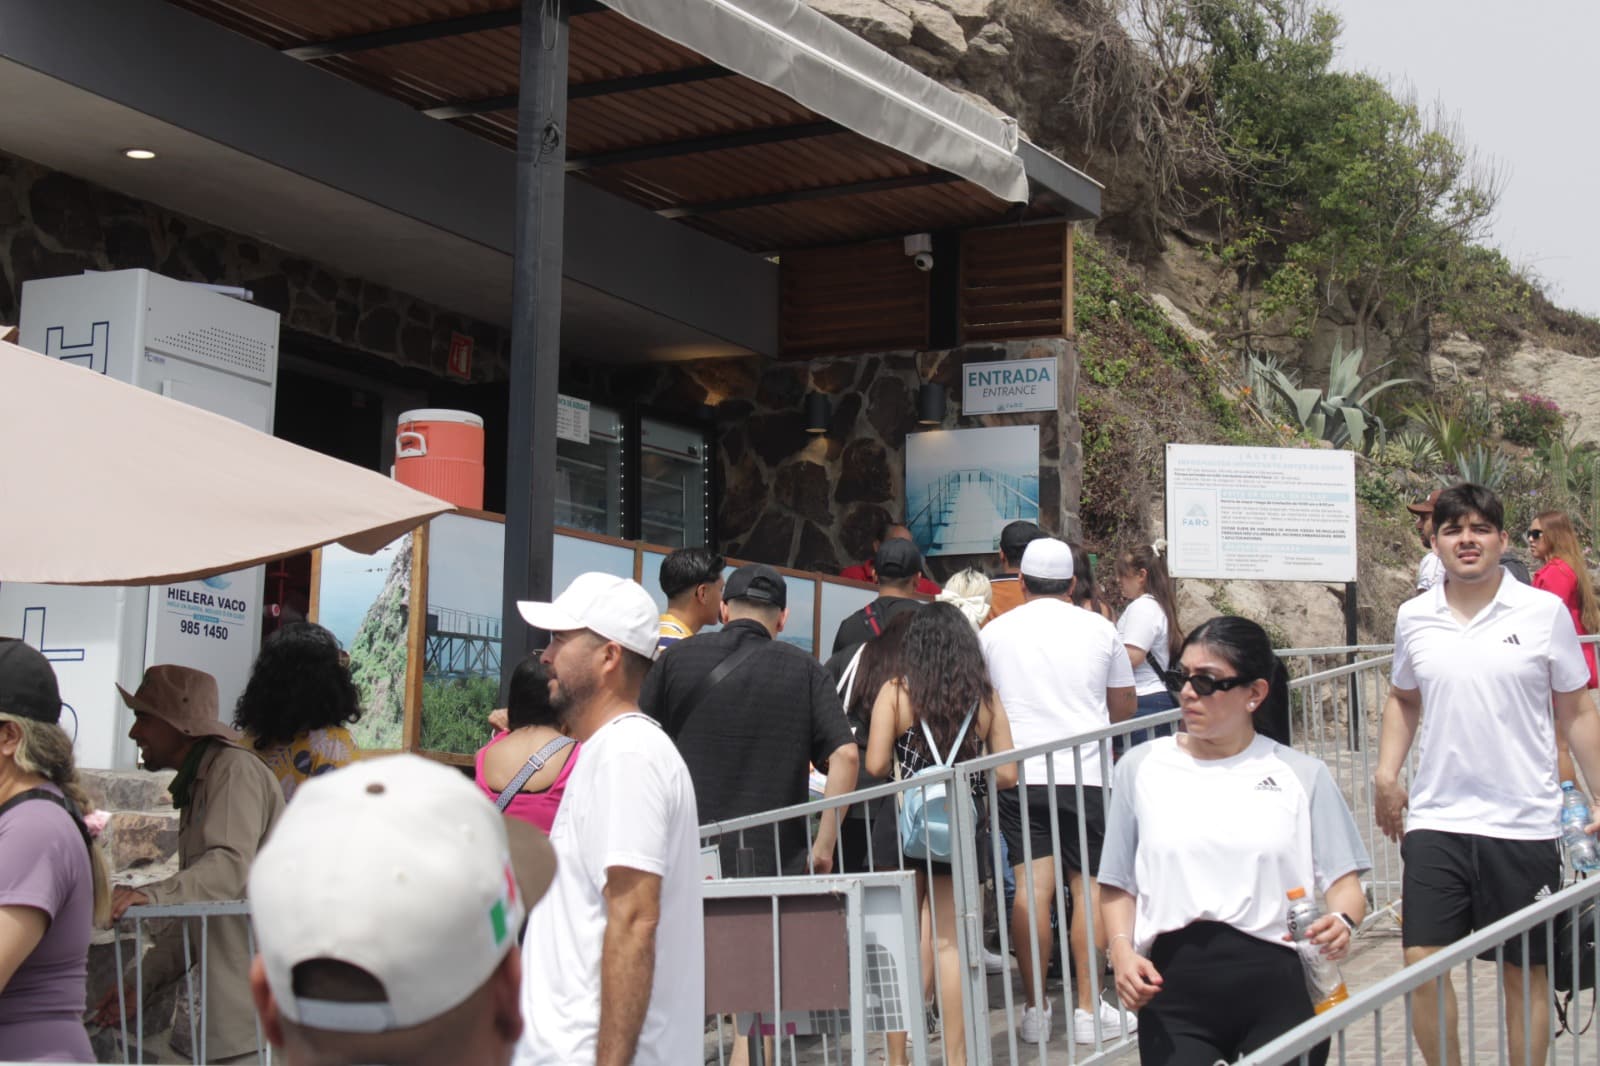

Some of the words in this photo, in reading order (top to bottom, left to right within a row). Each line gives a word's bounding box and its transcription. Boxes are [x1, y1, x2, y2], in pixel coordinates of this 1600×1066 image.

[968, 367, 1050, 387] ENTRADA
[982, 384, 1037, 398] ENTRANCE
[1182, 519, 1209, 527] FARO
[167, 587, 215, 607] HIELERA
[218, 597, 246, 612] VACO
[180, 620, 200, 635] 985
[203, 624, 228, 640] 1450
